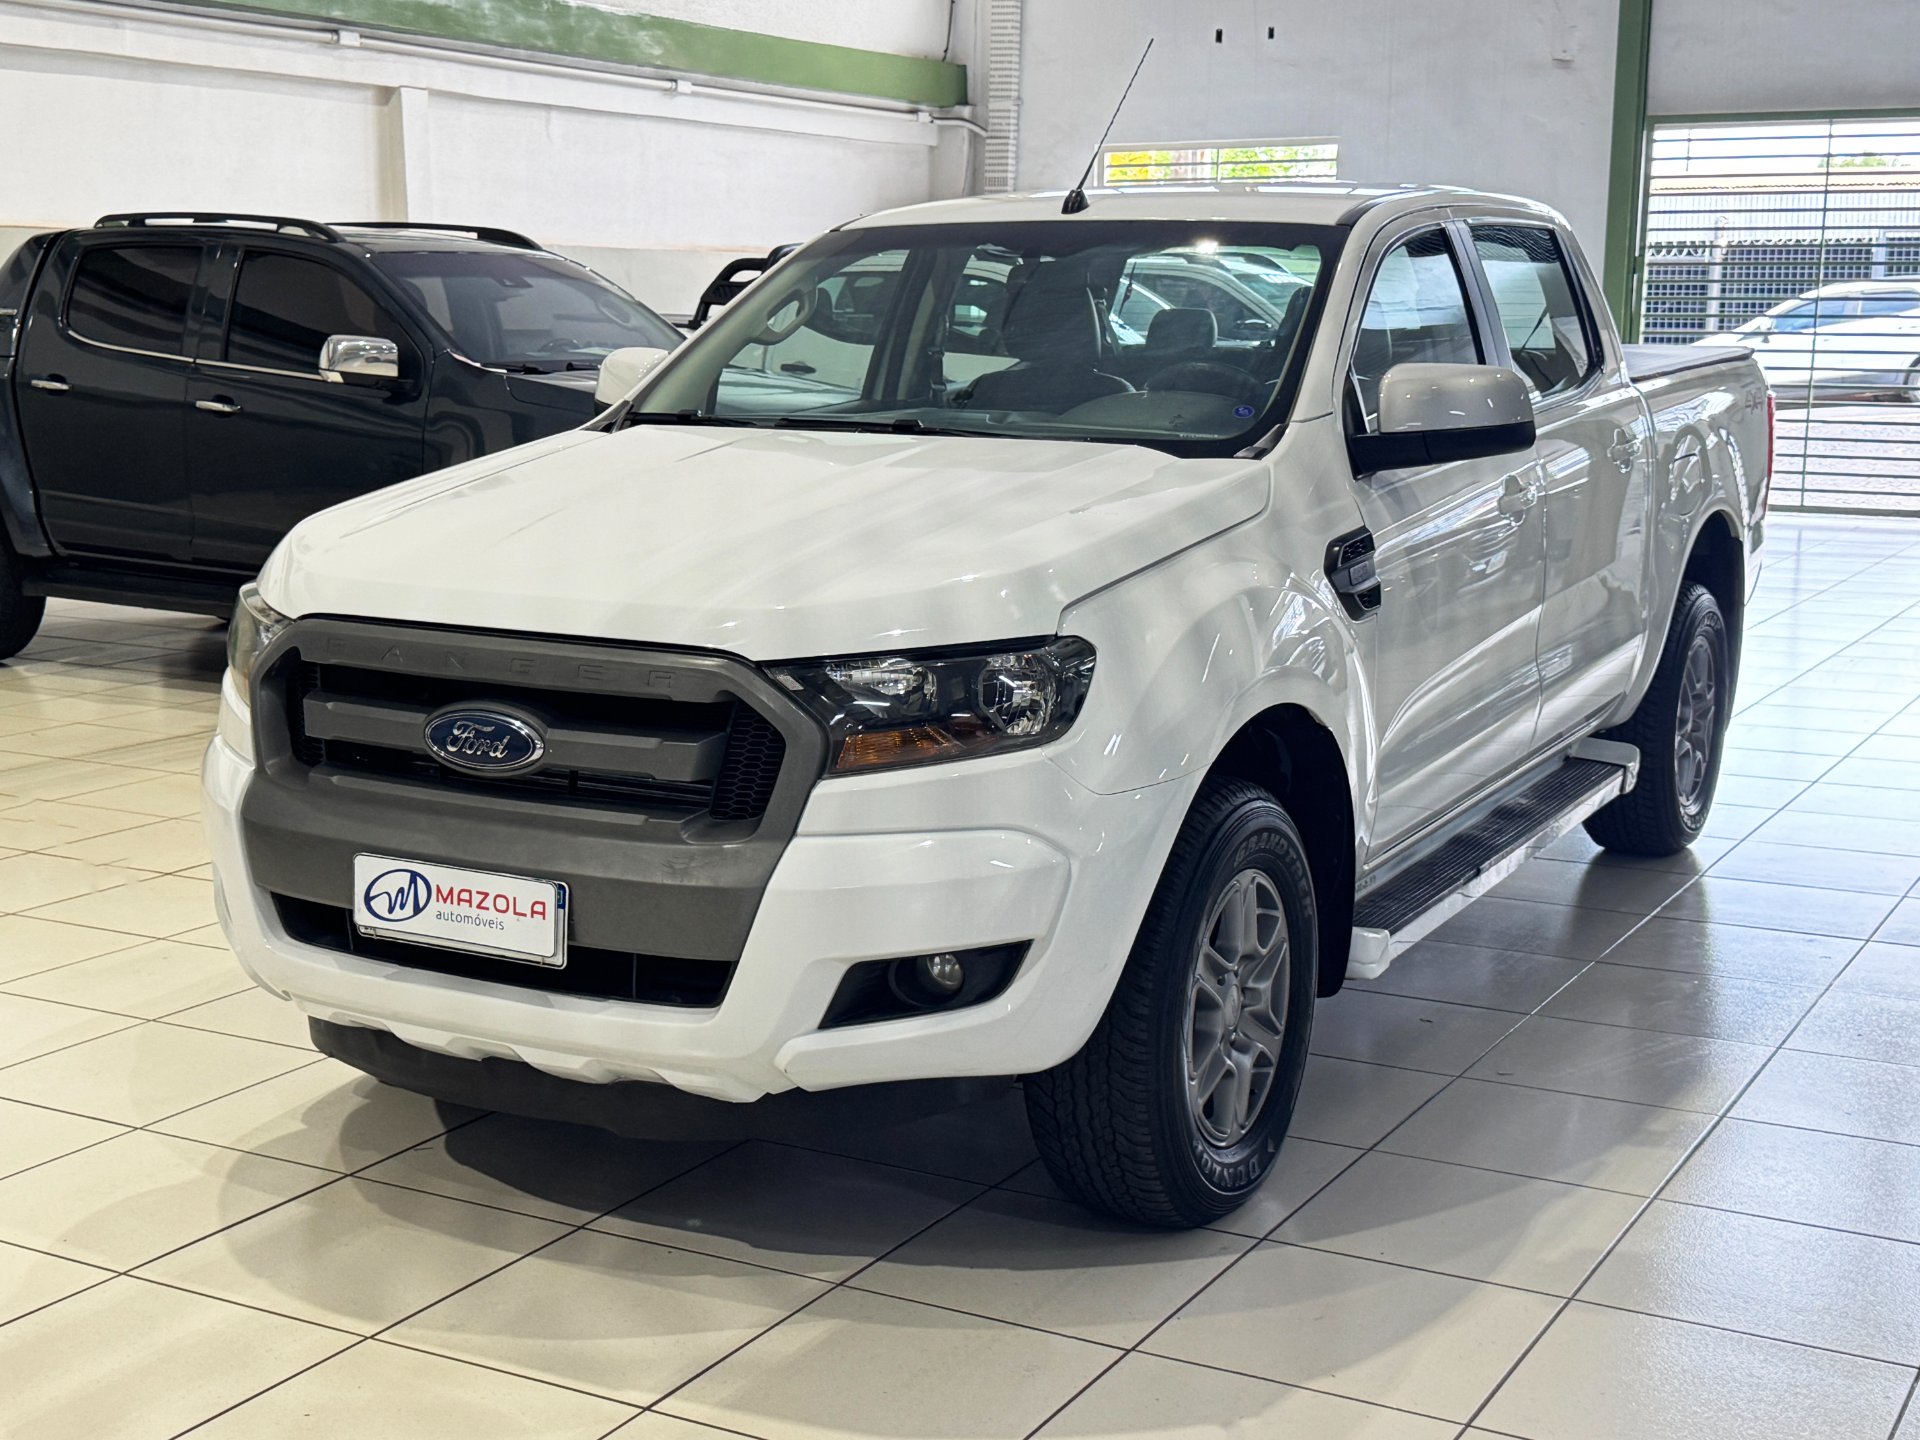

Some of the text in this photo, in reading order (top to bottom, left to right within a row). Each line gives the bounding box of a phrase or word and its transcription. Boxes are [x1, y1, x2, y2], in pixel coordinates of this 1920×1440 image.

[326, 637, 672, 688] RANGER
[446, 721, 510, 760] Ford
[436, 884, 546, 920] MAZOLA
[436, 909, 505, 931] automóveis
